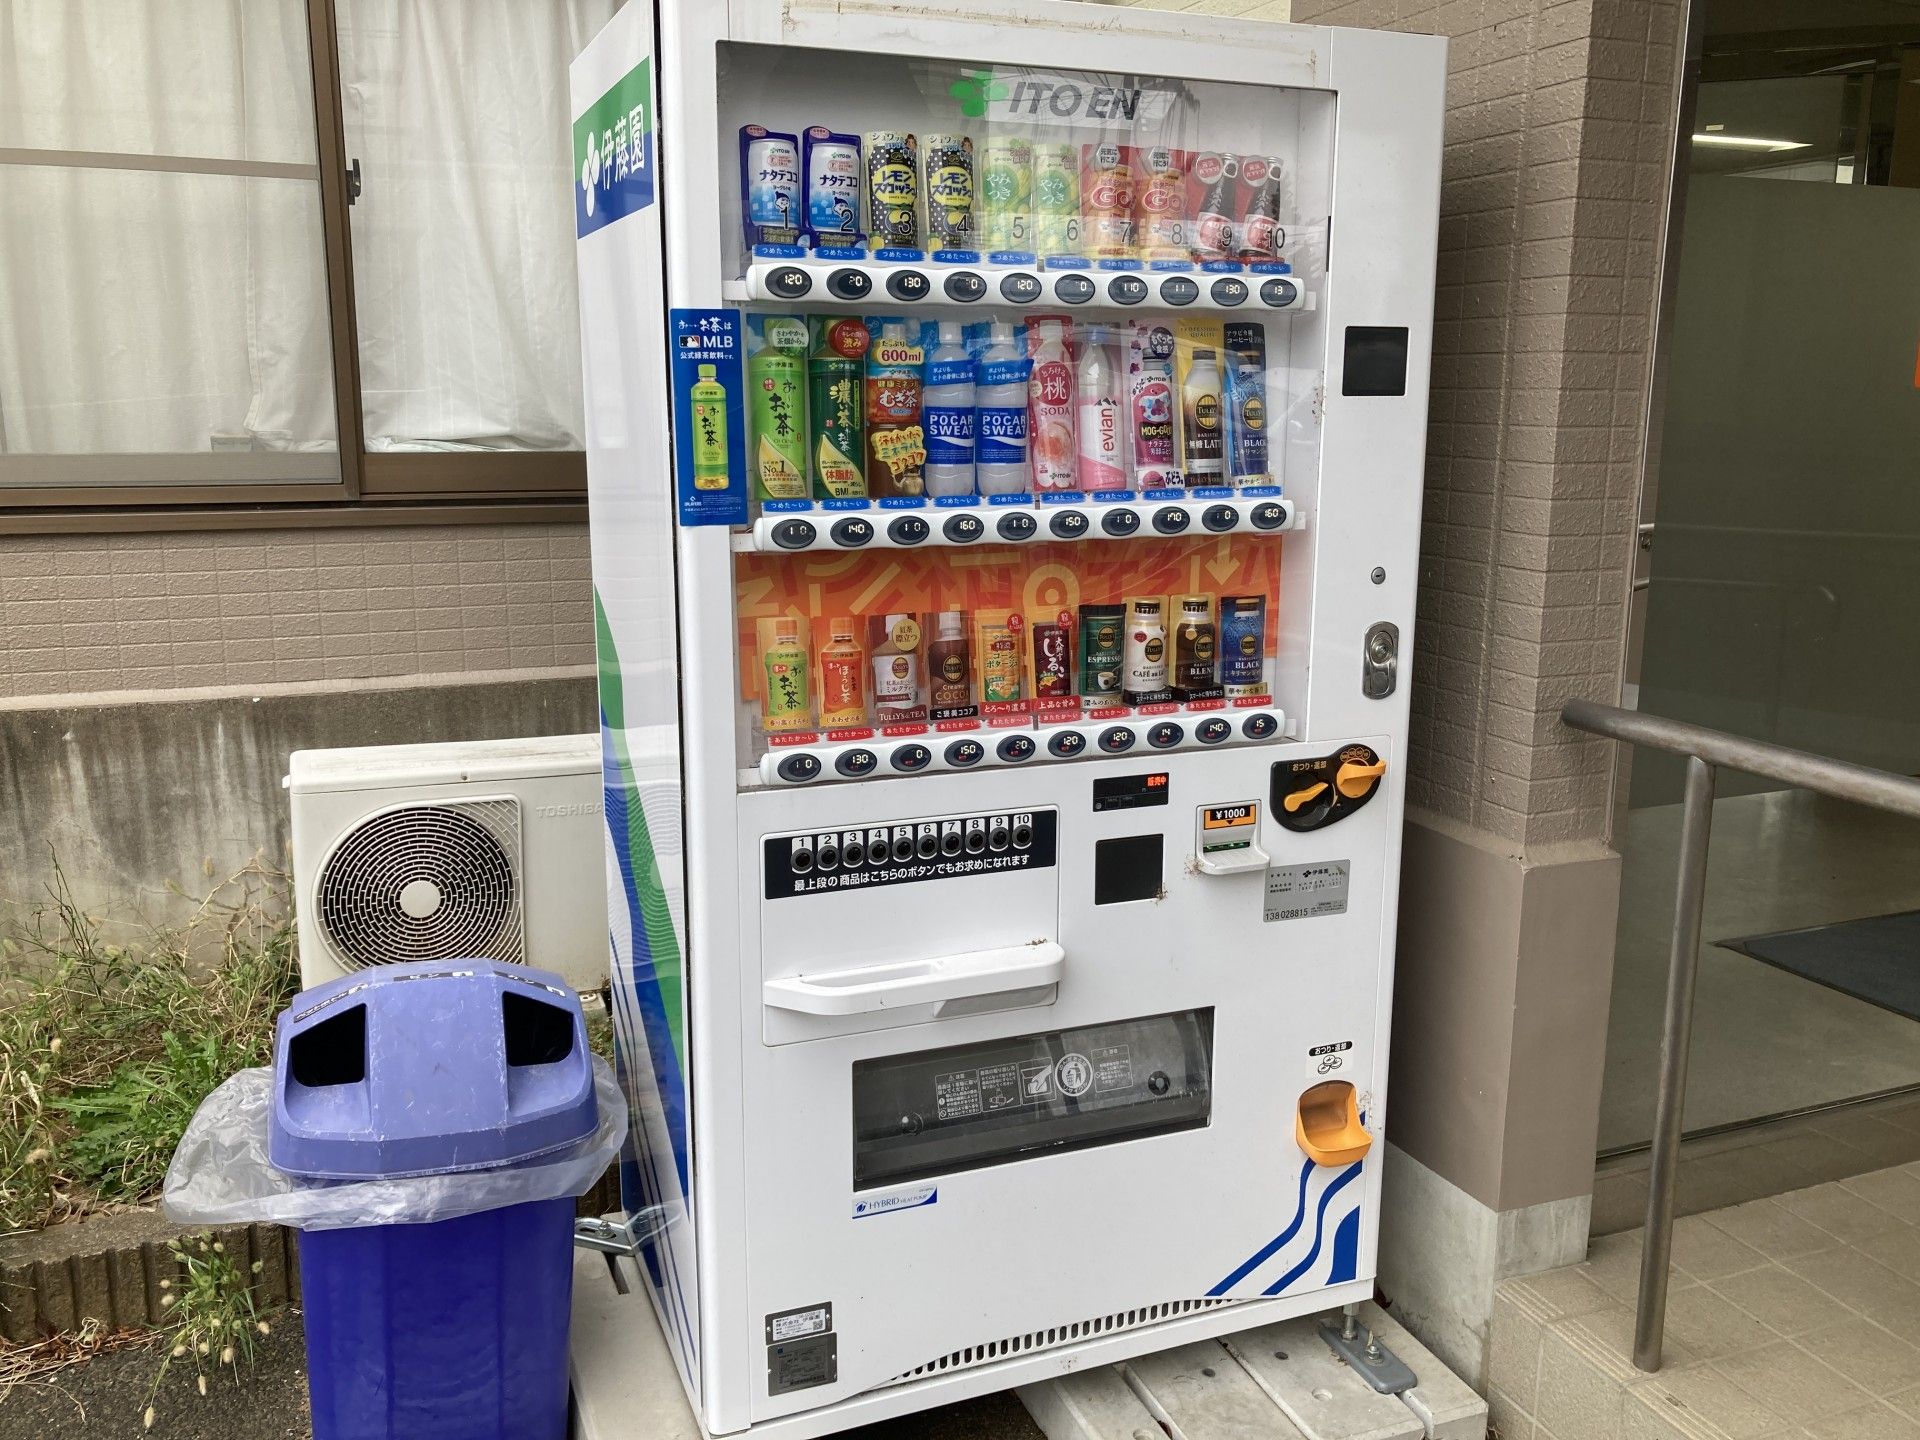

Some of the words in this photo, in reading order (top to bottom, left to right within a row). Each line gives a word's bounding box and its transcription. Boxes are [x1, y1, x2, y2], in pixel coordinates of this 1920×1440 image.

[1009, 81, 1082, 117] ITO
[1085, 86, 1142, 120] EN
[601, 103, 645, 190] 伊藤園
[759, 170, 798, 184] ナタテココ
[819, 174, 858, 188] ナタテココ
[882, 170, 912, 182] レモン
[940, 172, 969, 183] レモン
[780, 206, 789, 231] 1
[840, 209, 854, 233] 2
[899, 211, 912, 235] 3
[956, 214, 970, 238] 4
[1012, 216, 1024, 239] 5
[1066, 218, 1079, 241] 6
[1119, 221, 1132, 243] 7
[1171, 223, 1183, 245] 8
[1222, 225, 1233, 247] 9
[1267, 227, 1286, 249] 10
[784, 274, 803, 285] 120
[904, 277, 921, 288] 130
[1016, 280, 1033, 290] 120
[1123, 282, 1139, 292] 110
[1225, 284, 1240, 294] 130
[703, 335, 734, 348] MLB
[881, 349, 921, 362] 600ml
[1041, 367, 1066, 377] とろける
[1044, 377, 1067, 401] 桃
[879, 389, 918, 408] むぎ茶
[768, 392, 795, 437] お茶
[1040, 407, 1071, 416] SODA
[929, 425, 974, 436] SWEAT
[1100, 408, 1115, 452] evian
[891, 451, 924, 472] ゴクゴク
[1263, 508, 1279, 518] 160
[959, 520, 976, 530] 160
[1065, 516, 1081, 526] 150
[848, 524, 866, 534] 140
[900, 625, 913, 634] 紅茶
[992, 652, 1016, 660] コーン
[1043, 637, 1065, 678] しるこ
[1087, 655, 1121, 663] ESPRESSO
[986, 659, 1018, 669] ポタージュ
[1235, 661, 1260, 669] BLACK
[1132, 669, 1150, 678] CAFÉ
[778, 674, 801, 710] お茶
[1039, 700, 1076, 709] 上品な甘み
[936, 707, 974, 719] ご褒美ココア
[1209, 723, 1224, 732] 140
[1063, 735, 1079, 746] 120
[1113, 731, 1128, 741] 120
[960, 744, 976, 754] 150
[852, 753, 869, 764] 130
[1147, 775, 1167, 787] 販売中
[536, 802, 602, 818] TOSHIBA
[1215, 807, 1246, 820] ¥1000
[972, 820, 979, 829] 8
[995, 817, 1003, 827] 9
[1016, 815, 1030, 824] 10
[899, 827, 907, 836] 5
[924, 825, 932, 834] 6
[948, 822, 955, 831] 7
[824, 835, 832, 845] 2
[849, 833, 857, 842] 3
[874, 830, 882, 839] 4
[799, 837, 805, 847] 1
[869, 1196, 900, 1210] HYBRID
